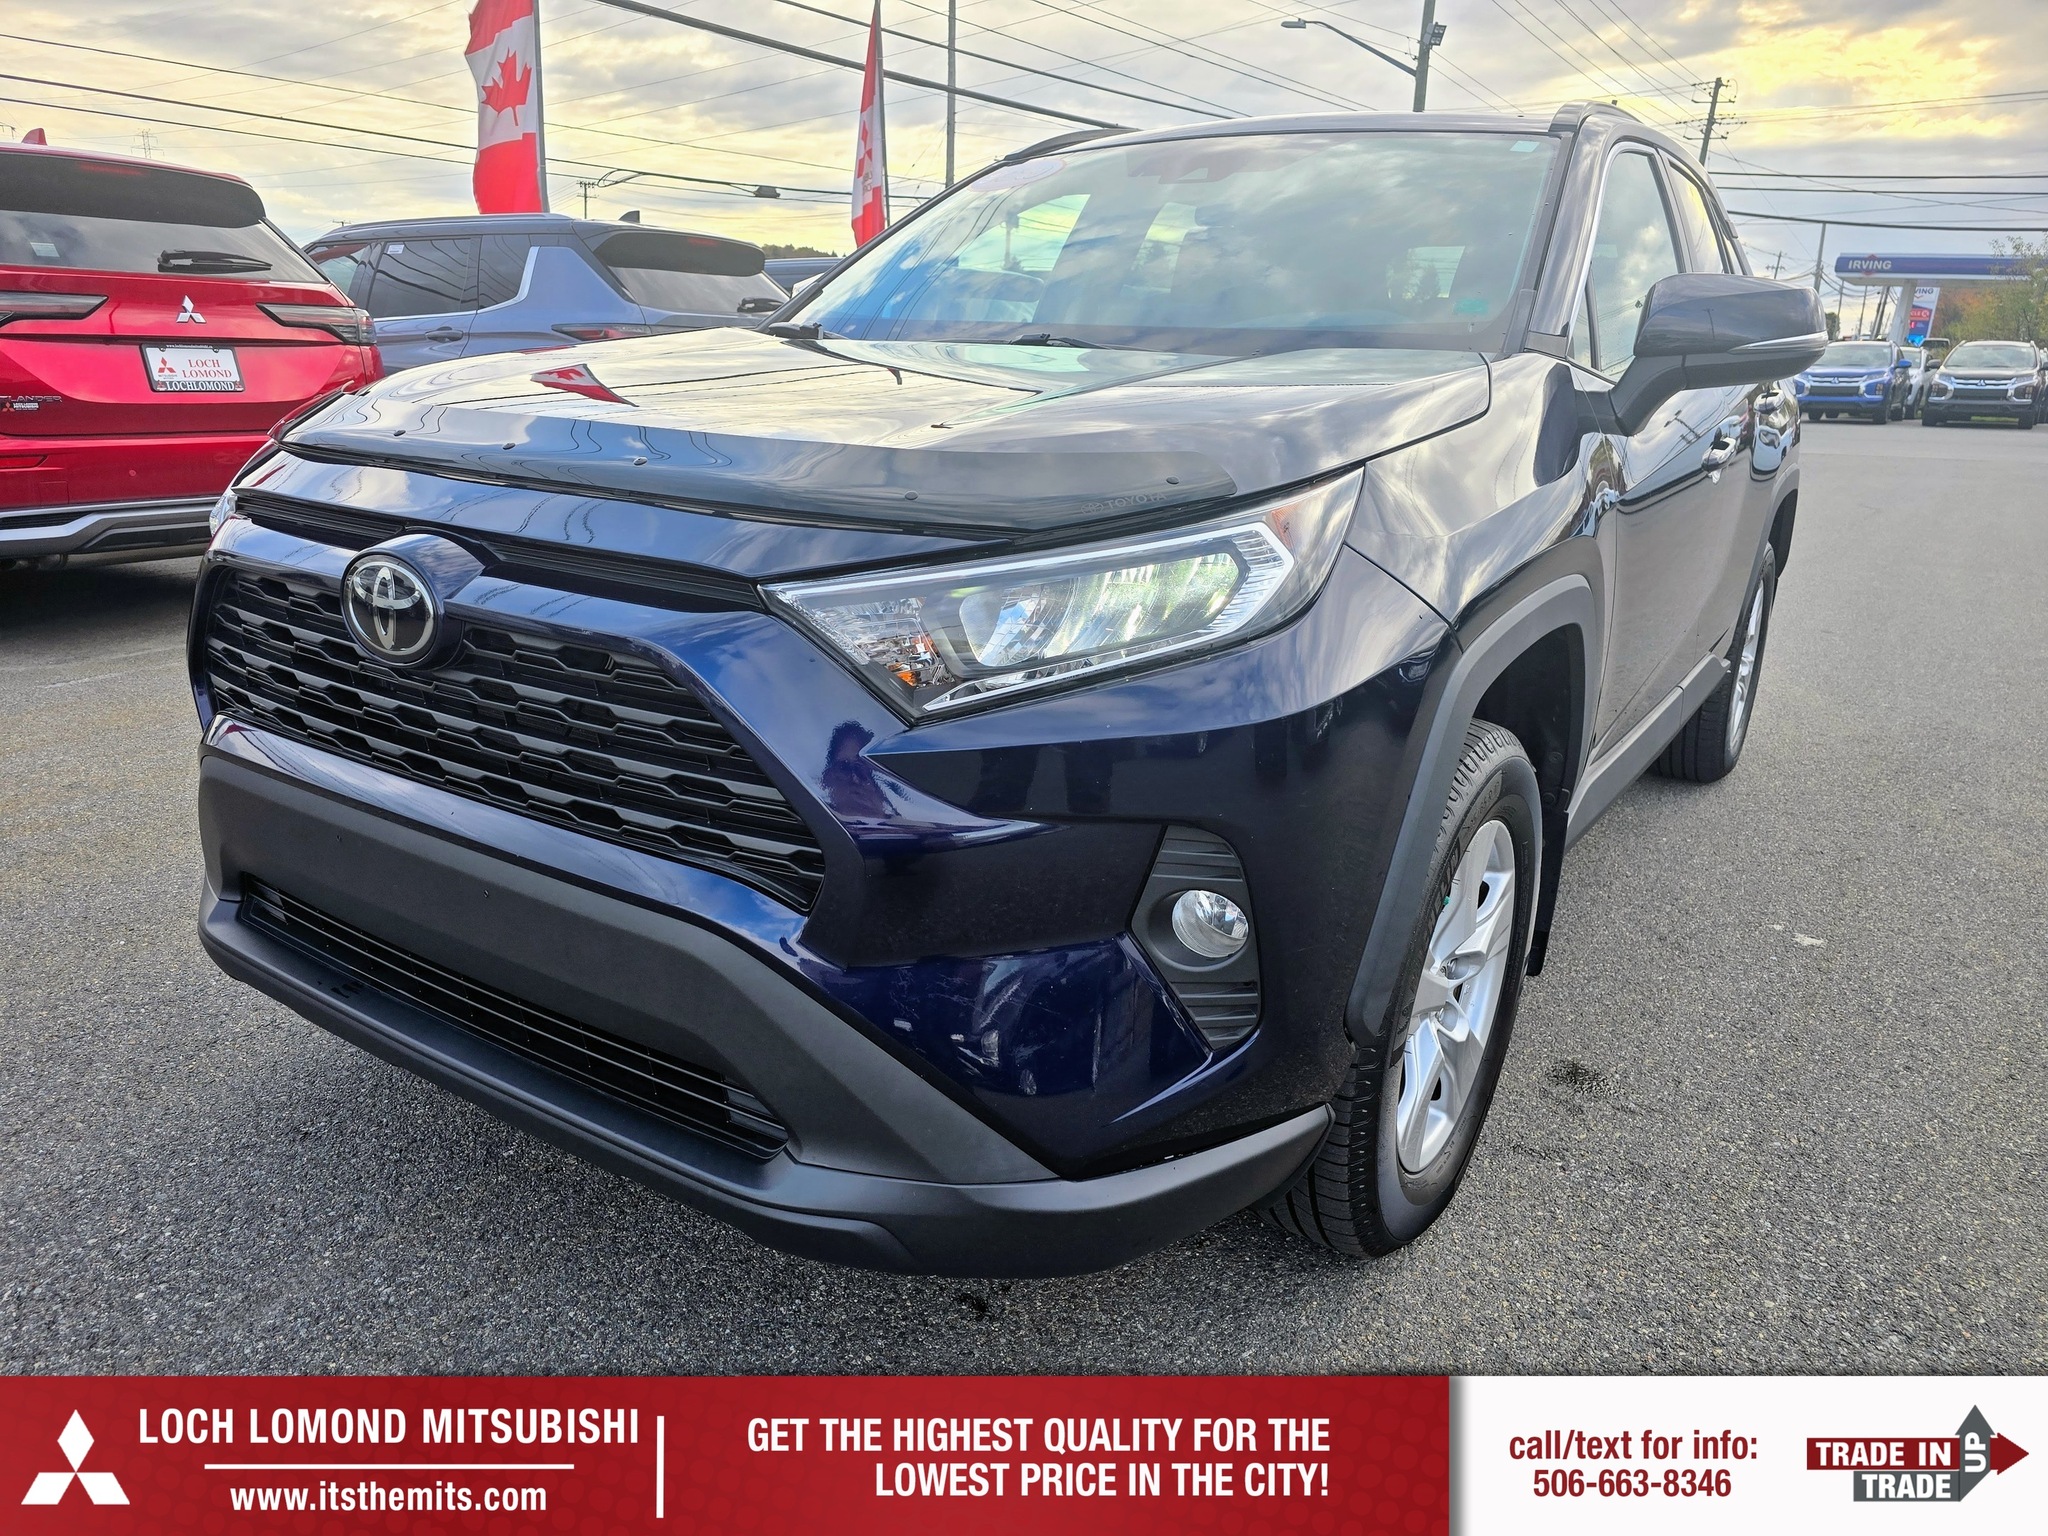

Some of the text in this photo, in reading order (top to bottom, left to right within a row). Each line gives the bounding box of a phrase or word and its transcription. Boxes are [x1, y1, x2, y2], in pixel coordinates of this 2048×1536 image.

[1848, 260, 1892, 270] IRVING
[187, 359, 221, 368] LOCH
[182, 369, 232, 378] LOMOND
[166, 381, 235, 391] LOCHLOMOND
[1105, 492, 1167, 509] TOYOTA
